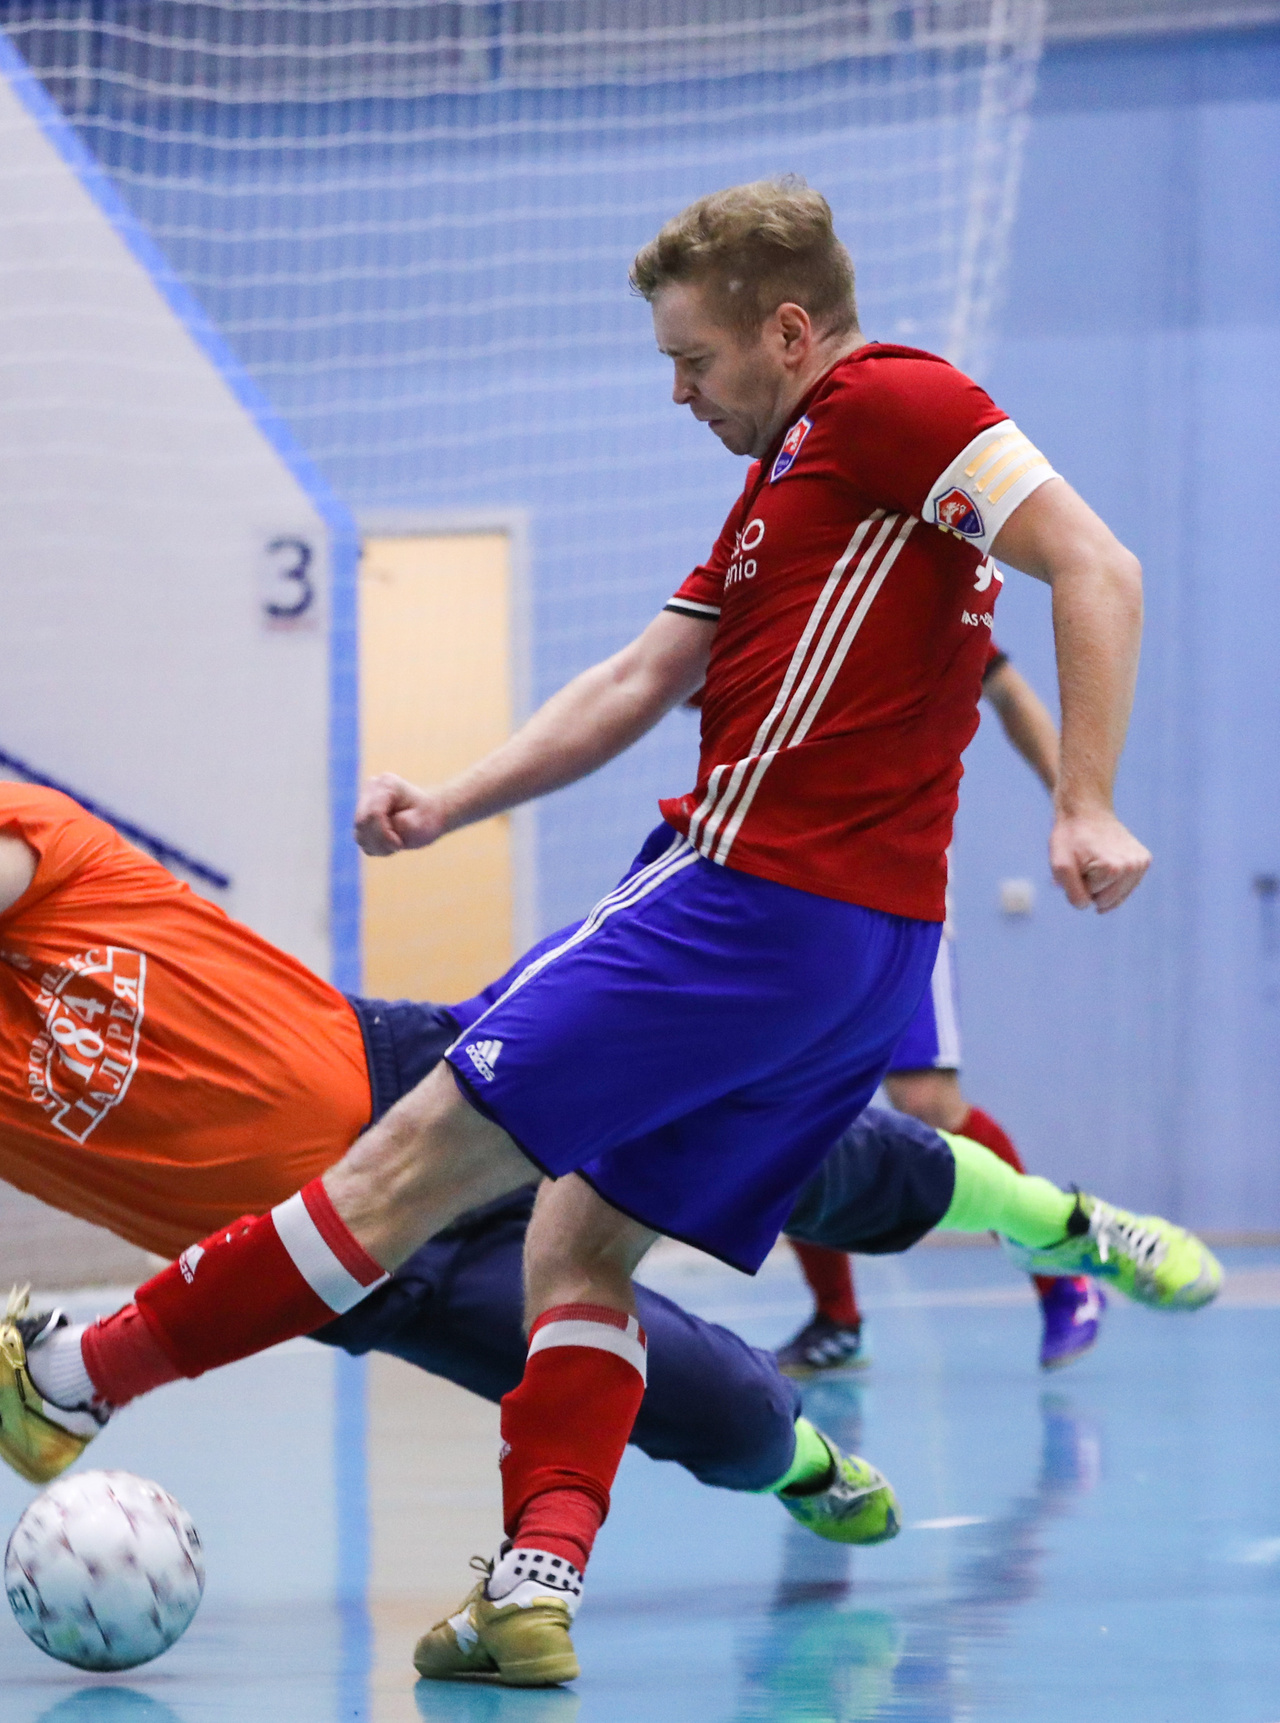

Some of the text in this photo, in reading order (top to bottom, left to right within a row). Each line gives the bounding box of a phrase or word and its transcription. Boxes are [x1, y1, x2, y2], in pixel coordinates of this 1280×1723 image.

[263, 534, 314, 618] 3
[74, 974, 139, 1118] ГАЛРЕЯ
[465, 1044, 496, 1082] adidas
